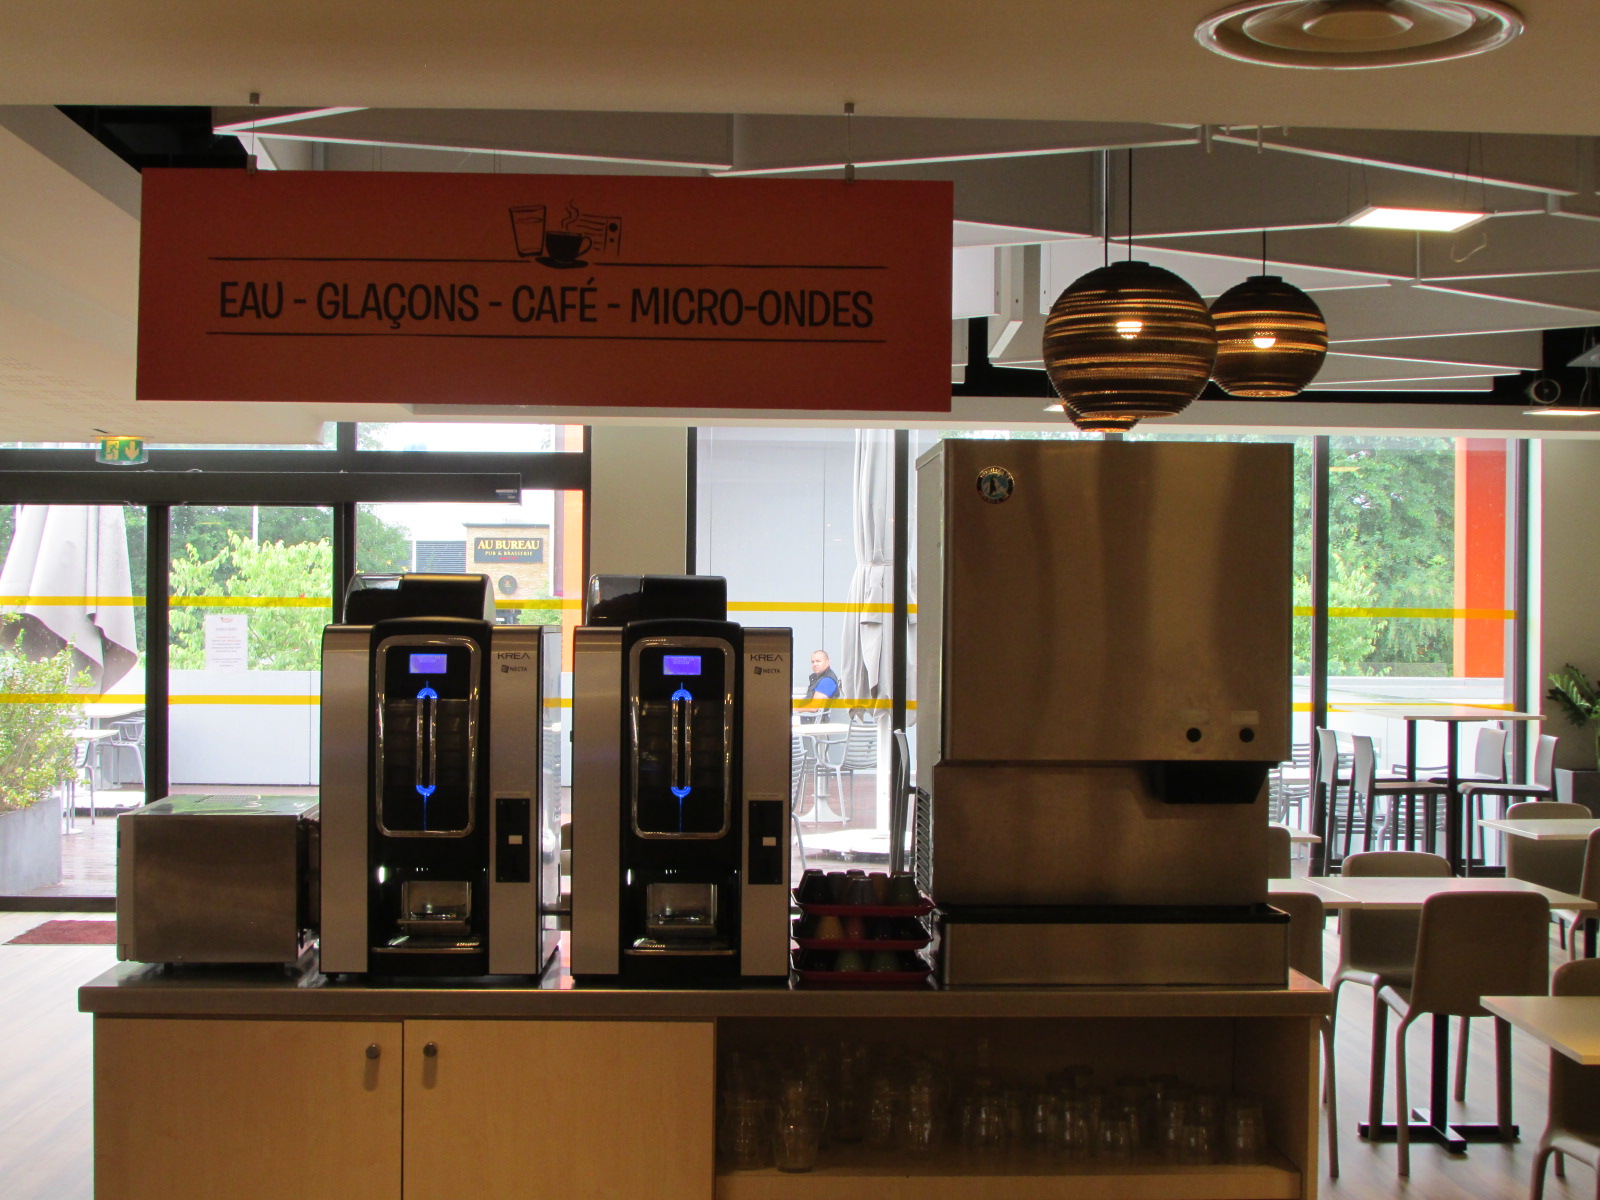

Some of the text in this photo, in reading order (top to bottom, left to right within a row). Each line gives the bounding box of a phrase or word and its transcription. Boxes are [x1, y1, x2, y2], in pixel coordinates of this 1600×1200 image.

[219, 281, 284, 319] EAU
[317, 281, 479, 329] GLAÇONS
[512, 276, 598, 323] CAFÉ
[631, 286, 874, 328] MICRO-ONDES
[478, 540, 540, 549] AU BUREAU
